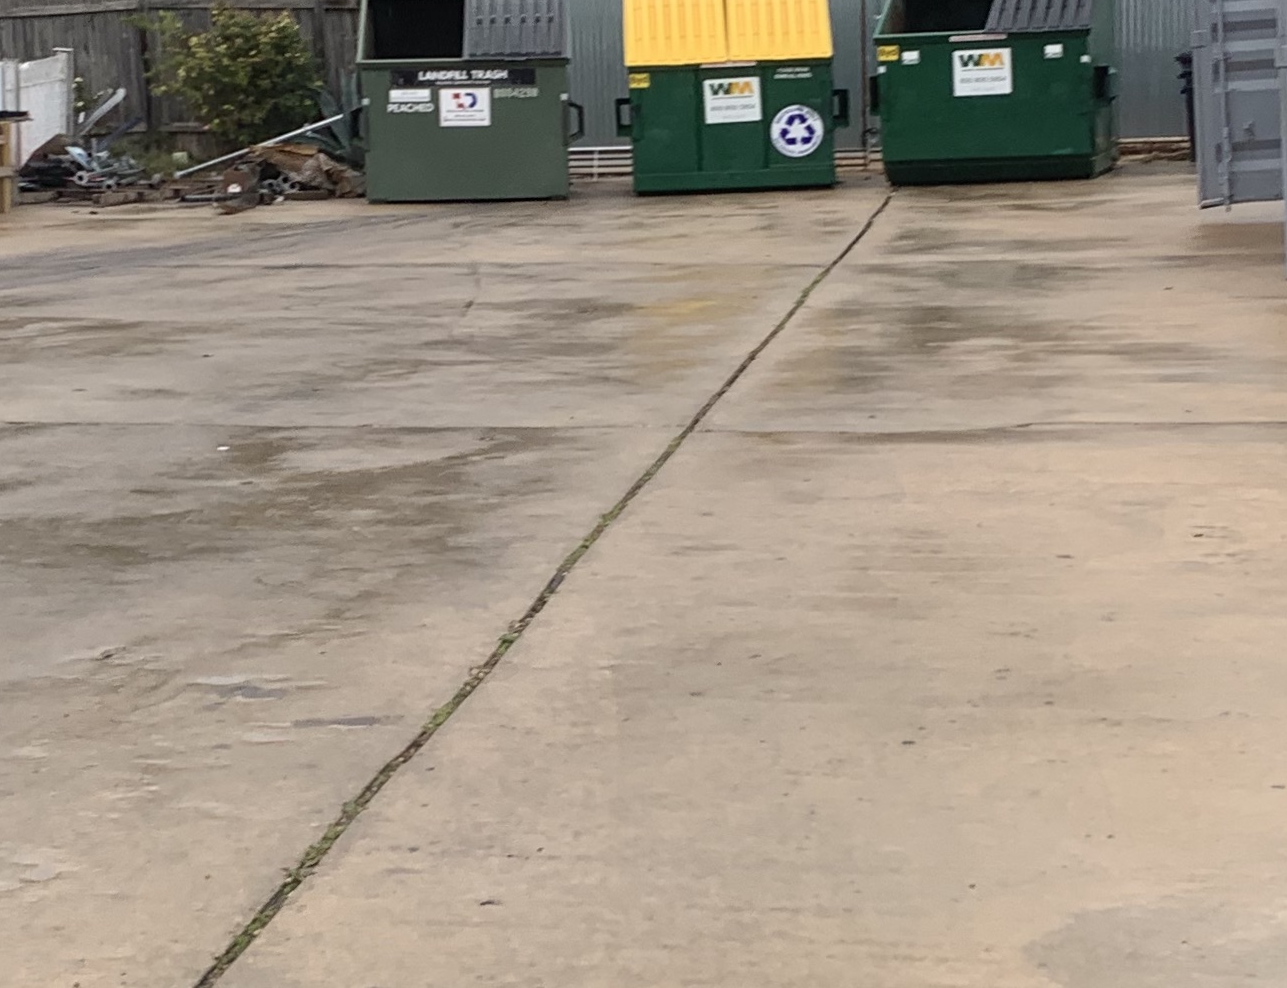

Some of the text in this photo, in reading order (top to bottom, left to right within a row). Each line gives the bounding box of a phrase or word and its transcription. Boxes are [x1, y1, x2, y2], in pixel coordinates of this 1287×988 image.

[418, 69, 509, 81] LANDFILL TRASH
[387, 103, 434, 112] PEACHED
